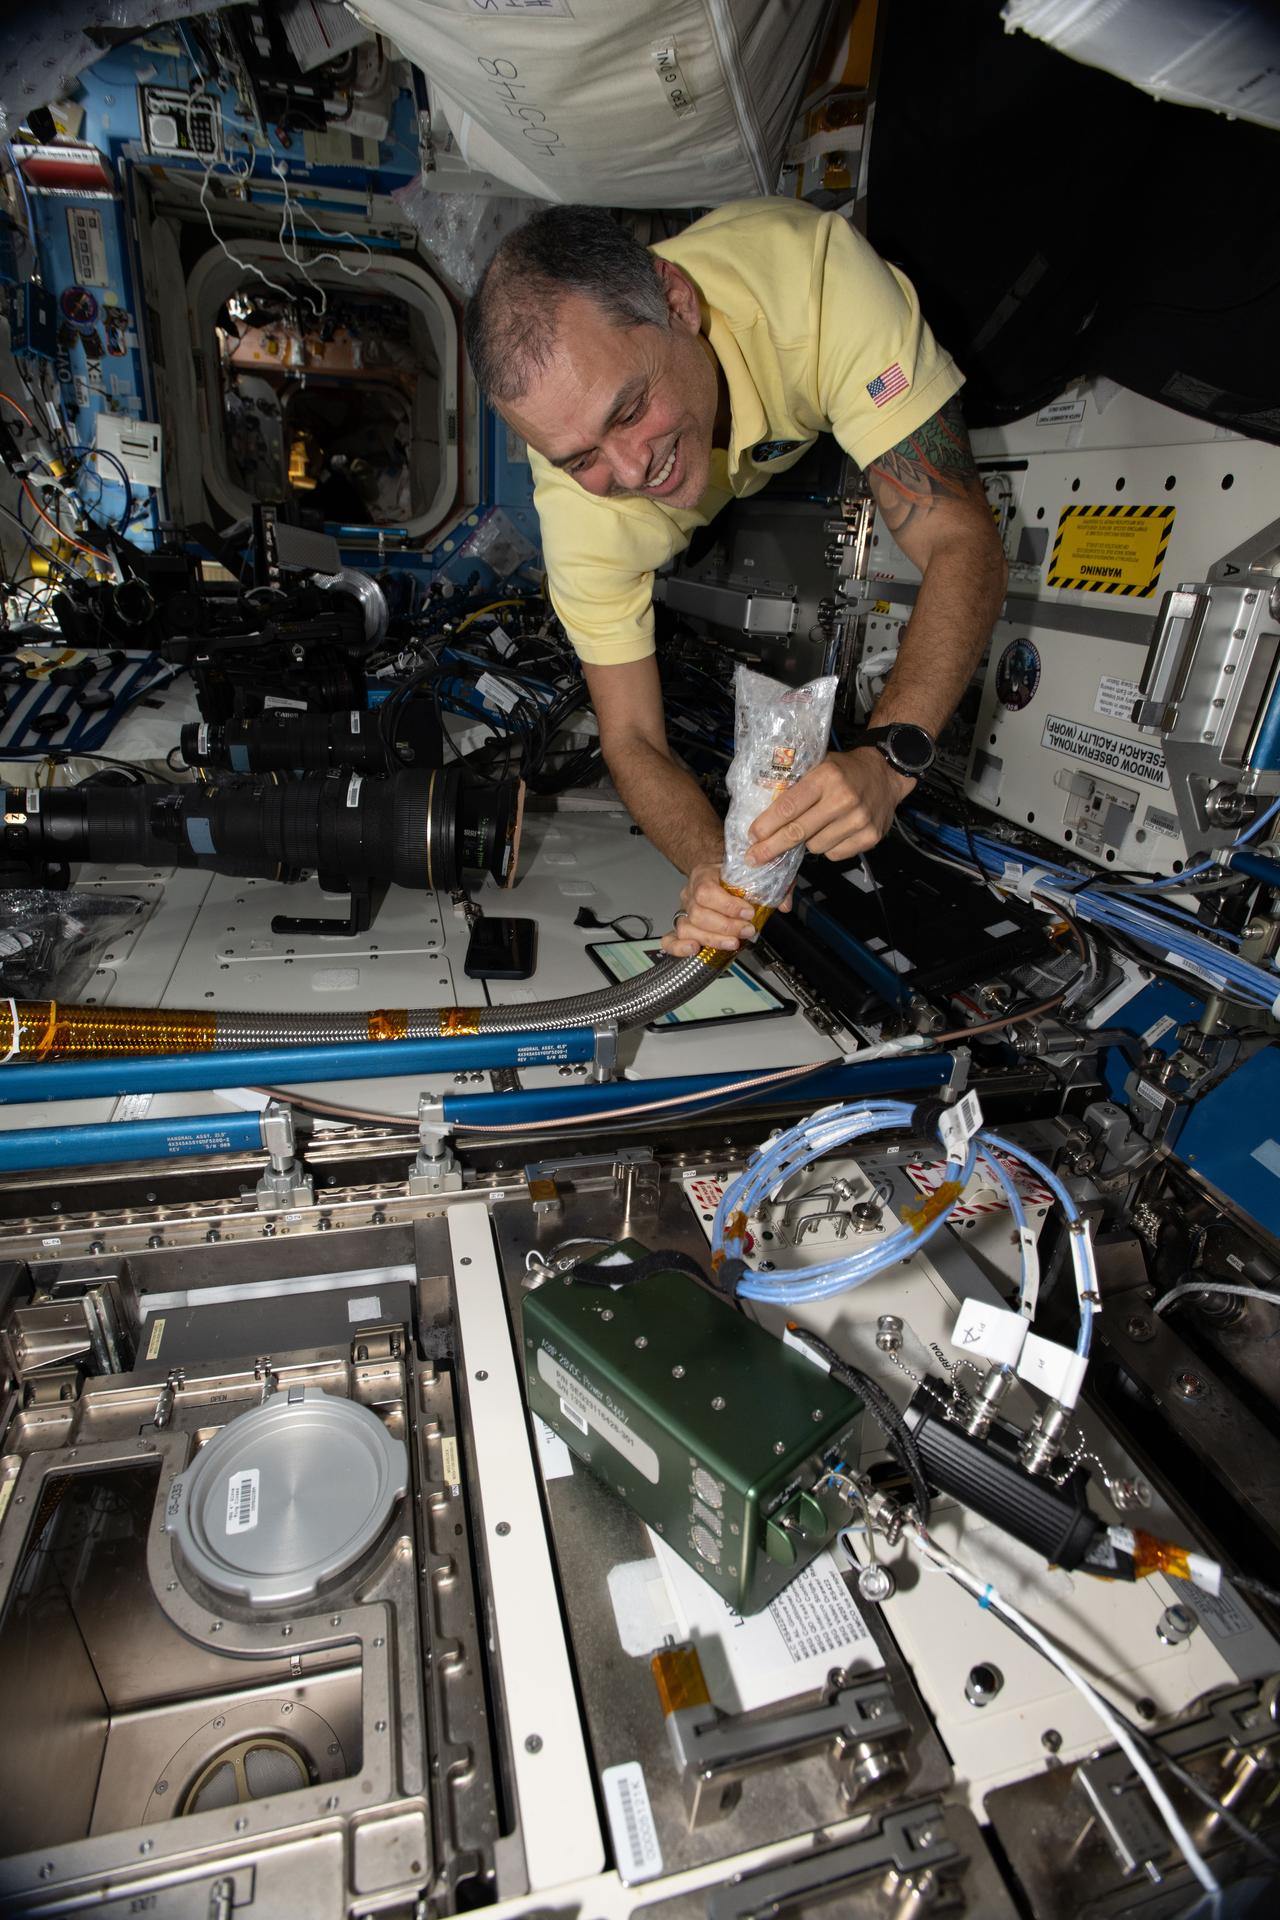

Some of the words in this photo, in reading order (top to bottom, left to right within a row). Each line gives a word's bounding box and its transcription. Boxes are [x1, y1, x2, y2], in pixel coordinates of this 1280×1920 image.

[663, 72, 677, 83] G
[669, 87, 687, 108] ERO
[1079, 565, 1122, 578] WARNING
[1223, 563, 1240, 576] A
[273, 710, 298, 718] Canon
[1045, 717, 1077, 738] (WORF)
[1046, 733, 1120, 767] OBSERVATIONAL
[1076, 730, 1117, 752] FACILITY
[1117, 742, 1167, 768] ESEARCH
[1119, 758, 1165, 782] WINDOW
[928, 1340, 953, 1373] (RPDA)
[583, 1373, 604, 1400] Power
[605, 1395, 629, 1425] Supply
